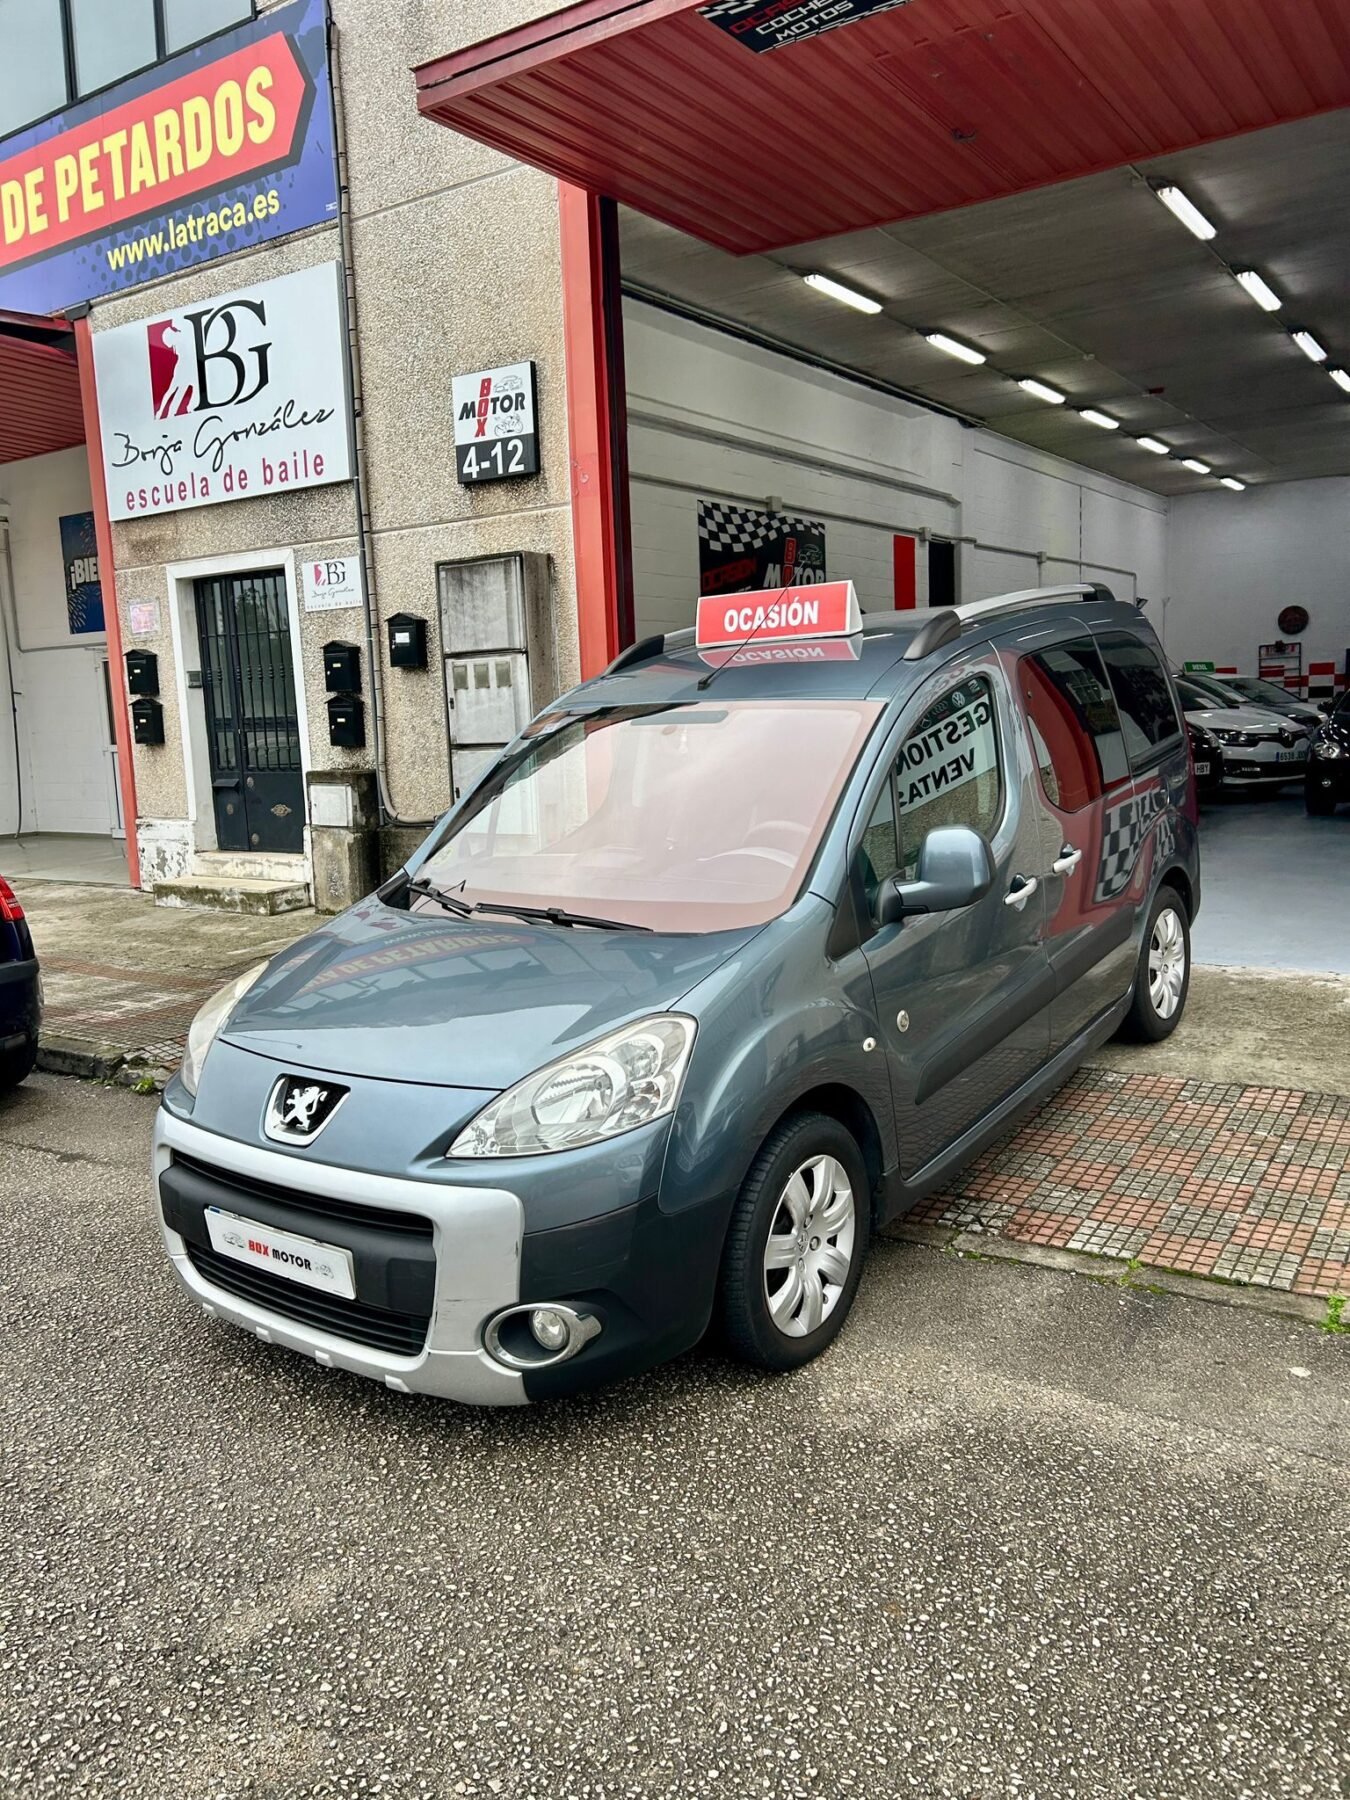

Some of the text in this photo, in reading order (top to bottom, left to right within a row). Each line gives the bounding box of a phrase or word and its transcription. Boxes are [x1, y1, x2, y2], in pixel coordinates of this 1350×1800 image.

[775, 1, 854, 41] MOTOS
[1, 65, 276, 245] DE PETARDOS
[107, 189, 279, 270] www.latraca.es
[184, 299, 272, 412] BG
[112, 400, 335, 475] Borja González
[463, 439, 524, 478] 4-12
[126, 450, 325, 510] escuela de baile
[724, 597, 819, 633] OCASIÓN
[272, 1248, 312, 1271] MOTOR
